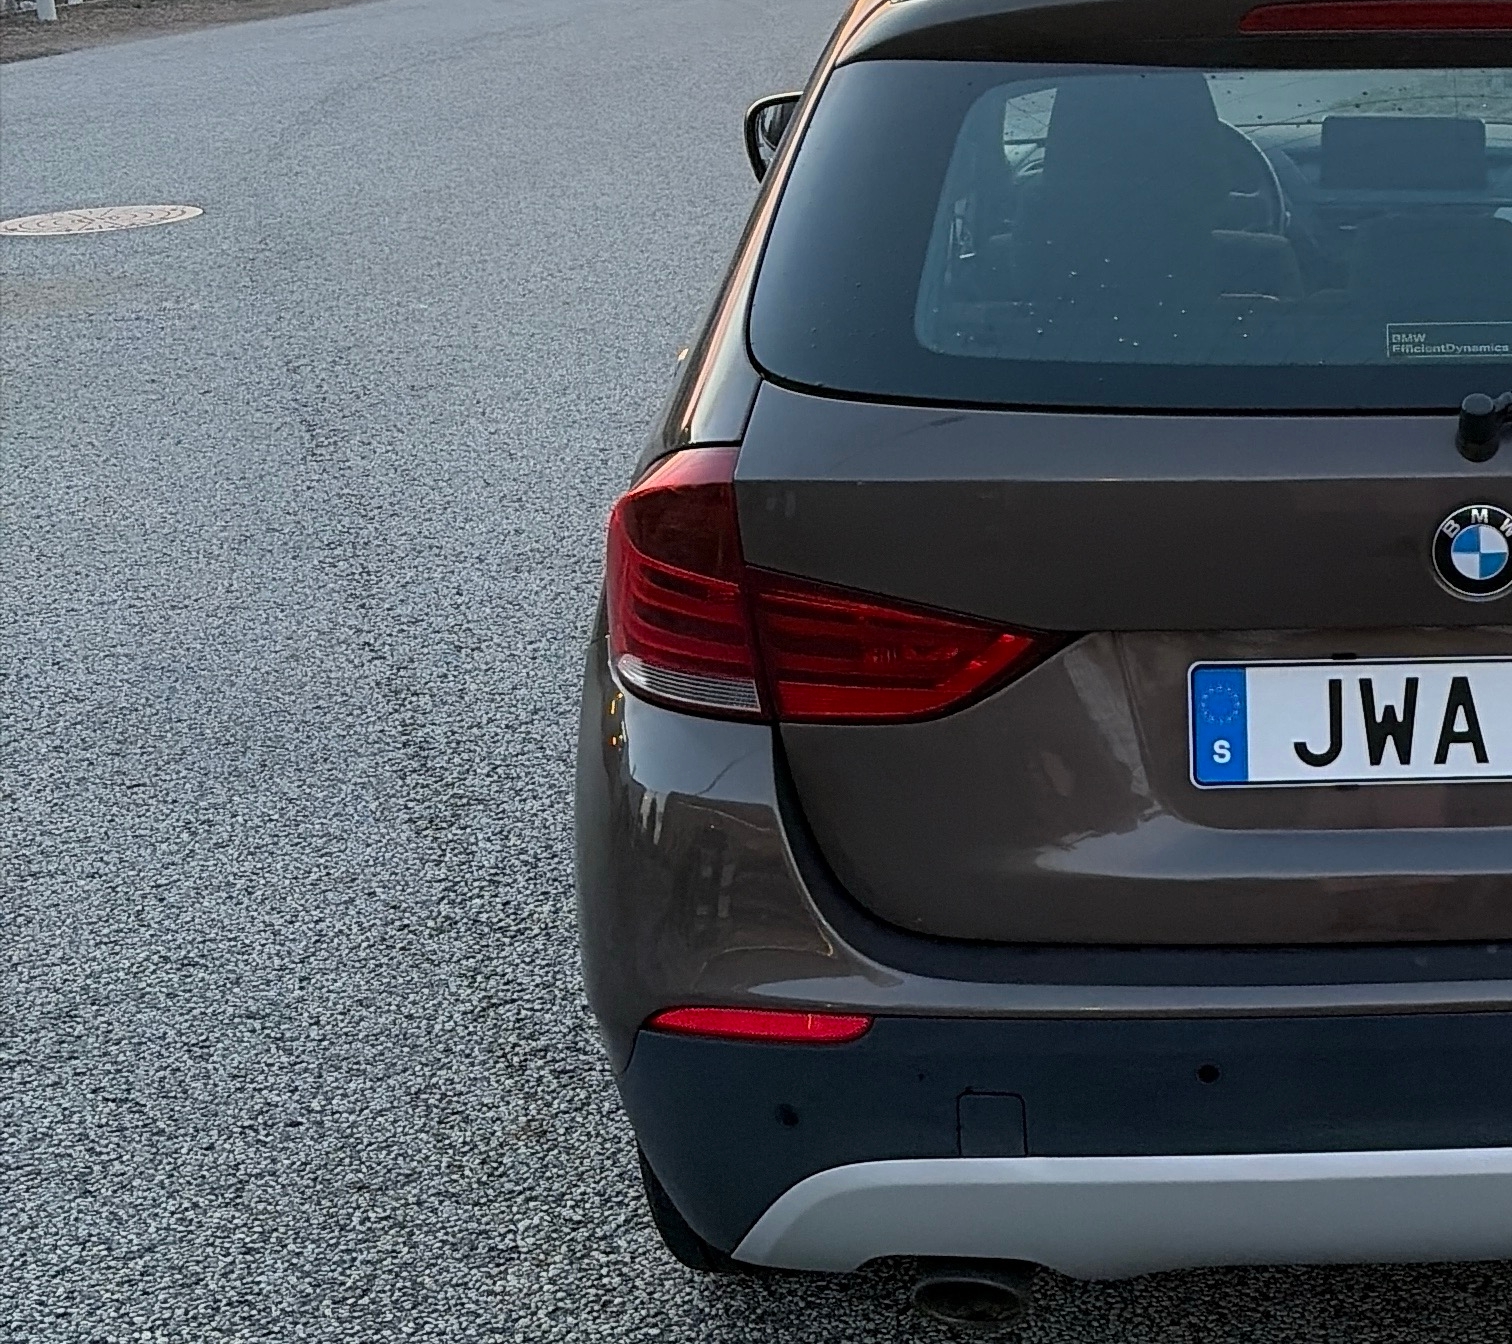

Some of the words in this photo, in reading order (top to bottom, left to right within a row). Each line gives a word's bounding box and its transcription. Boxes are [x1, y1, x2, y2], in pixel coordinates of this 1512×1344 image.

[1391, 333, 1427, 343] BMW
[1392, 343, 1510, 354] EfficientDynamics
[1211, 739, 1232, 765] S
[1293, 676, 1489, 768] JWA
